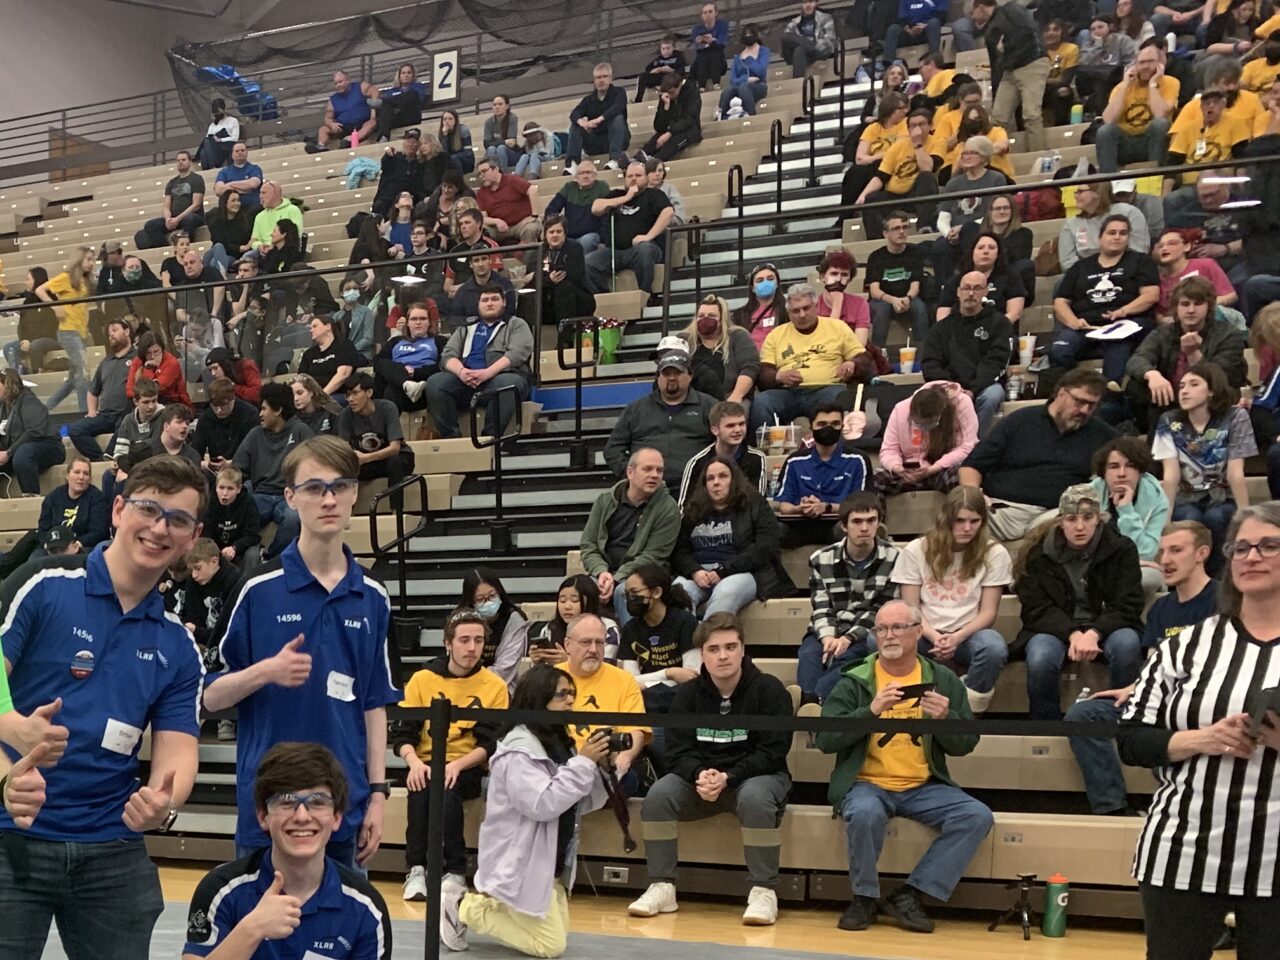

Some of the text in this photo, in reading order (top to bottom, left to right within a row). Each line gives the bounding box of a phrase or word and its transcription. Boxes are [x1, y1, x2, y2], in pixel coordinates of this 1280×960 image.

[438, 61, 453, 90] 2
[276, 613, 302, 623] 14596
[344, 619, 361, 629] XLAB
[313, 941, 334, 950] XLAB
